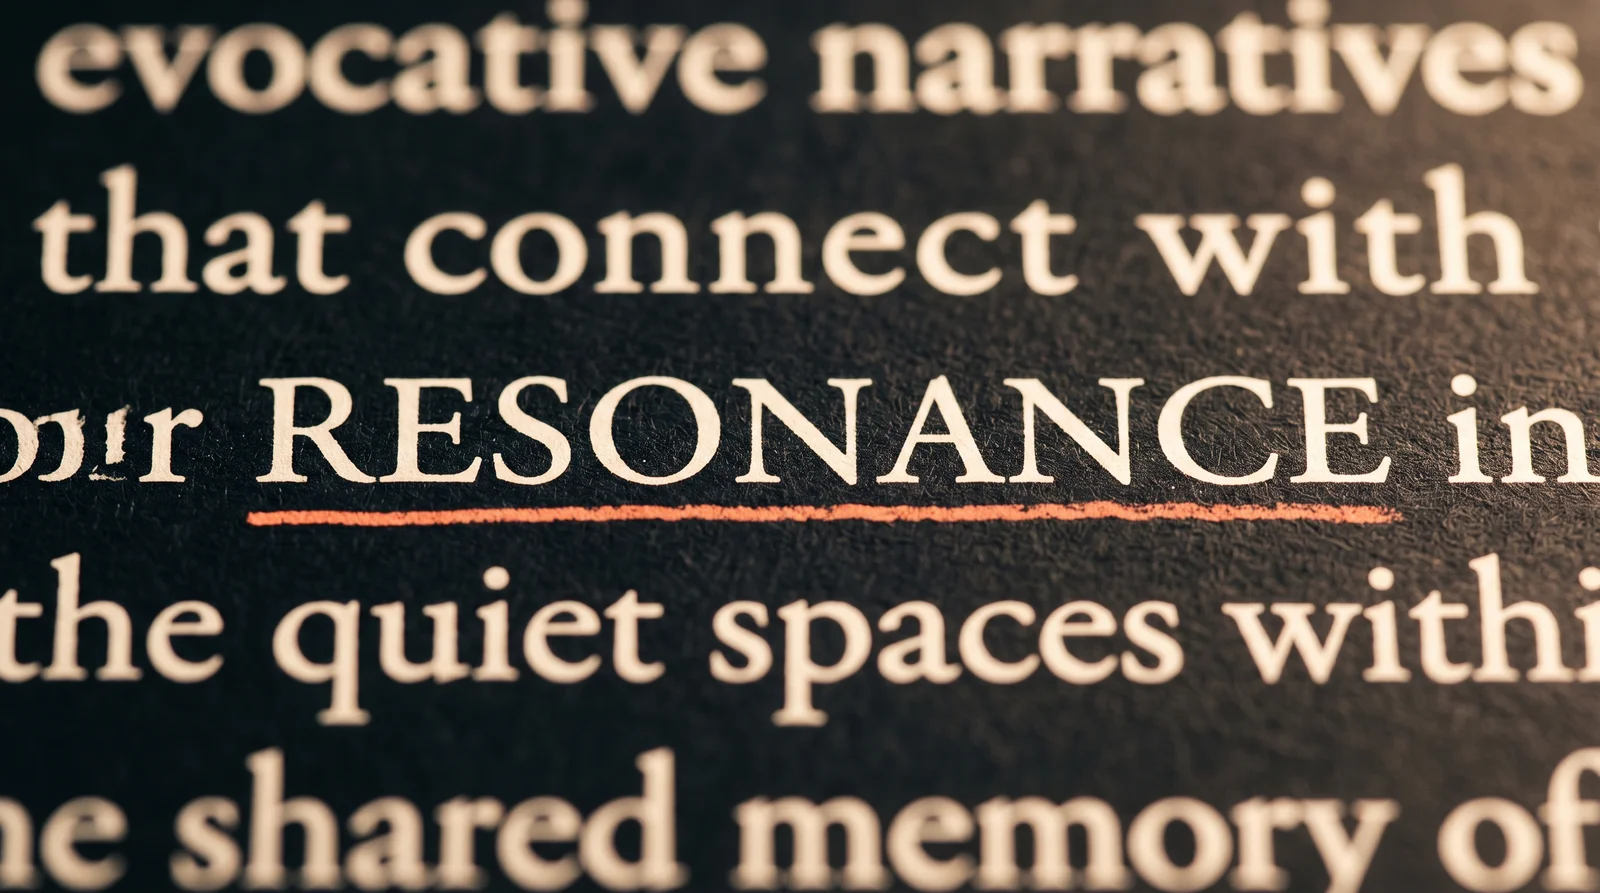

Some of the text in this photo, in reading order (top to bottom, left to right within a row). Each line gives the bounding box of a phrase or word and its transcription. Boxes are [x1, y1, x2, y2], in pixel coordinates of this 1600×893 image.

[36, 0, 1583, 115] evocative narratives
[34, 163, 1538, 298] that connect with
[256, 374, 1392, 486] RESONANCE
[1447, 374, 1600, 485] in
[0, 552, 225, 684] the
[272, 566, 666, 726] quiet
[708, 597, 1184, 727] spaces
[169, 746, 690, 893] shared
[733, 794, 1397, 893] memory
[1438, 747, 1600, 893] of
